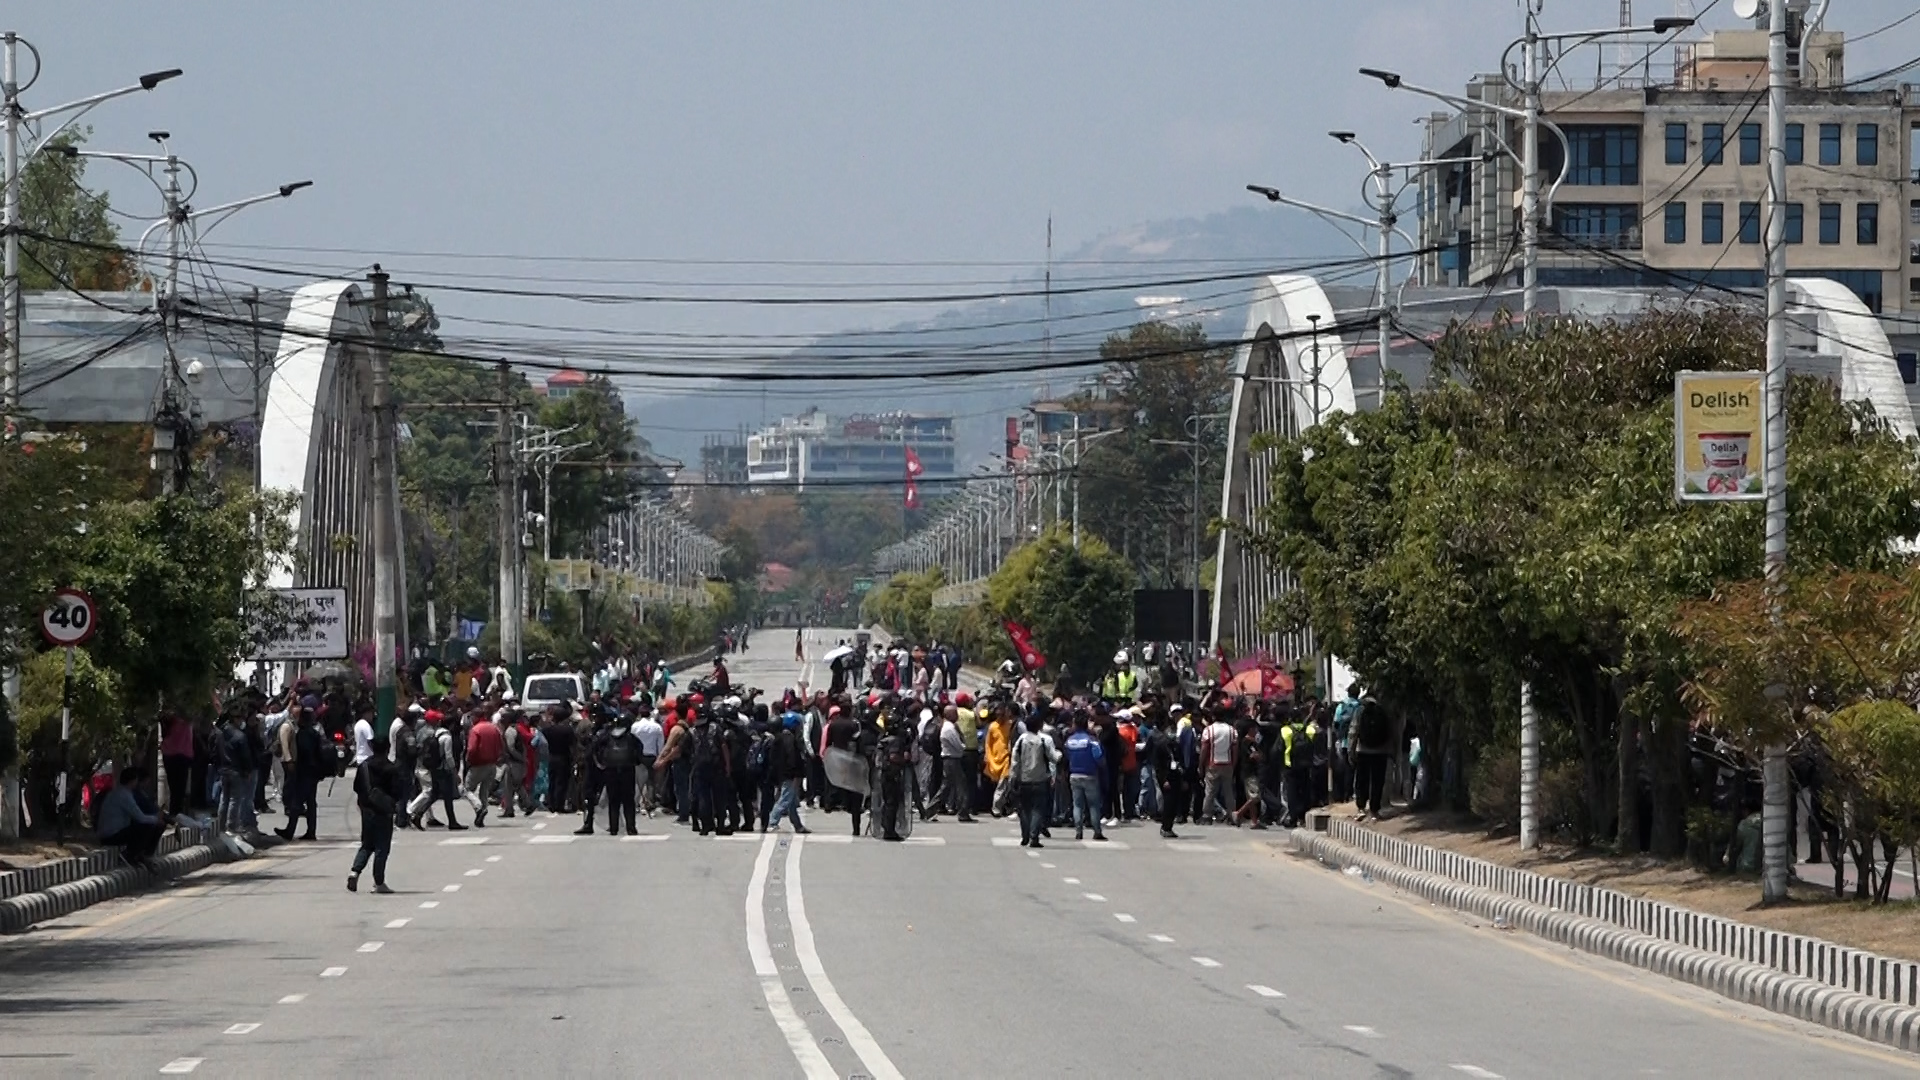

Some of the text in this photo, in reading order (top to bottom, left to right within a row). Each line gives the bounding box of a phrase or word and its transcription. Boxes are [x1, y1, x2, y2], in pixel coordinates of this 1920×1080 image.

[1690, 391, 1749, 408] Delish
[1711, 442, 1739, 452] Delish
[49, 604, 87, 629] 40
